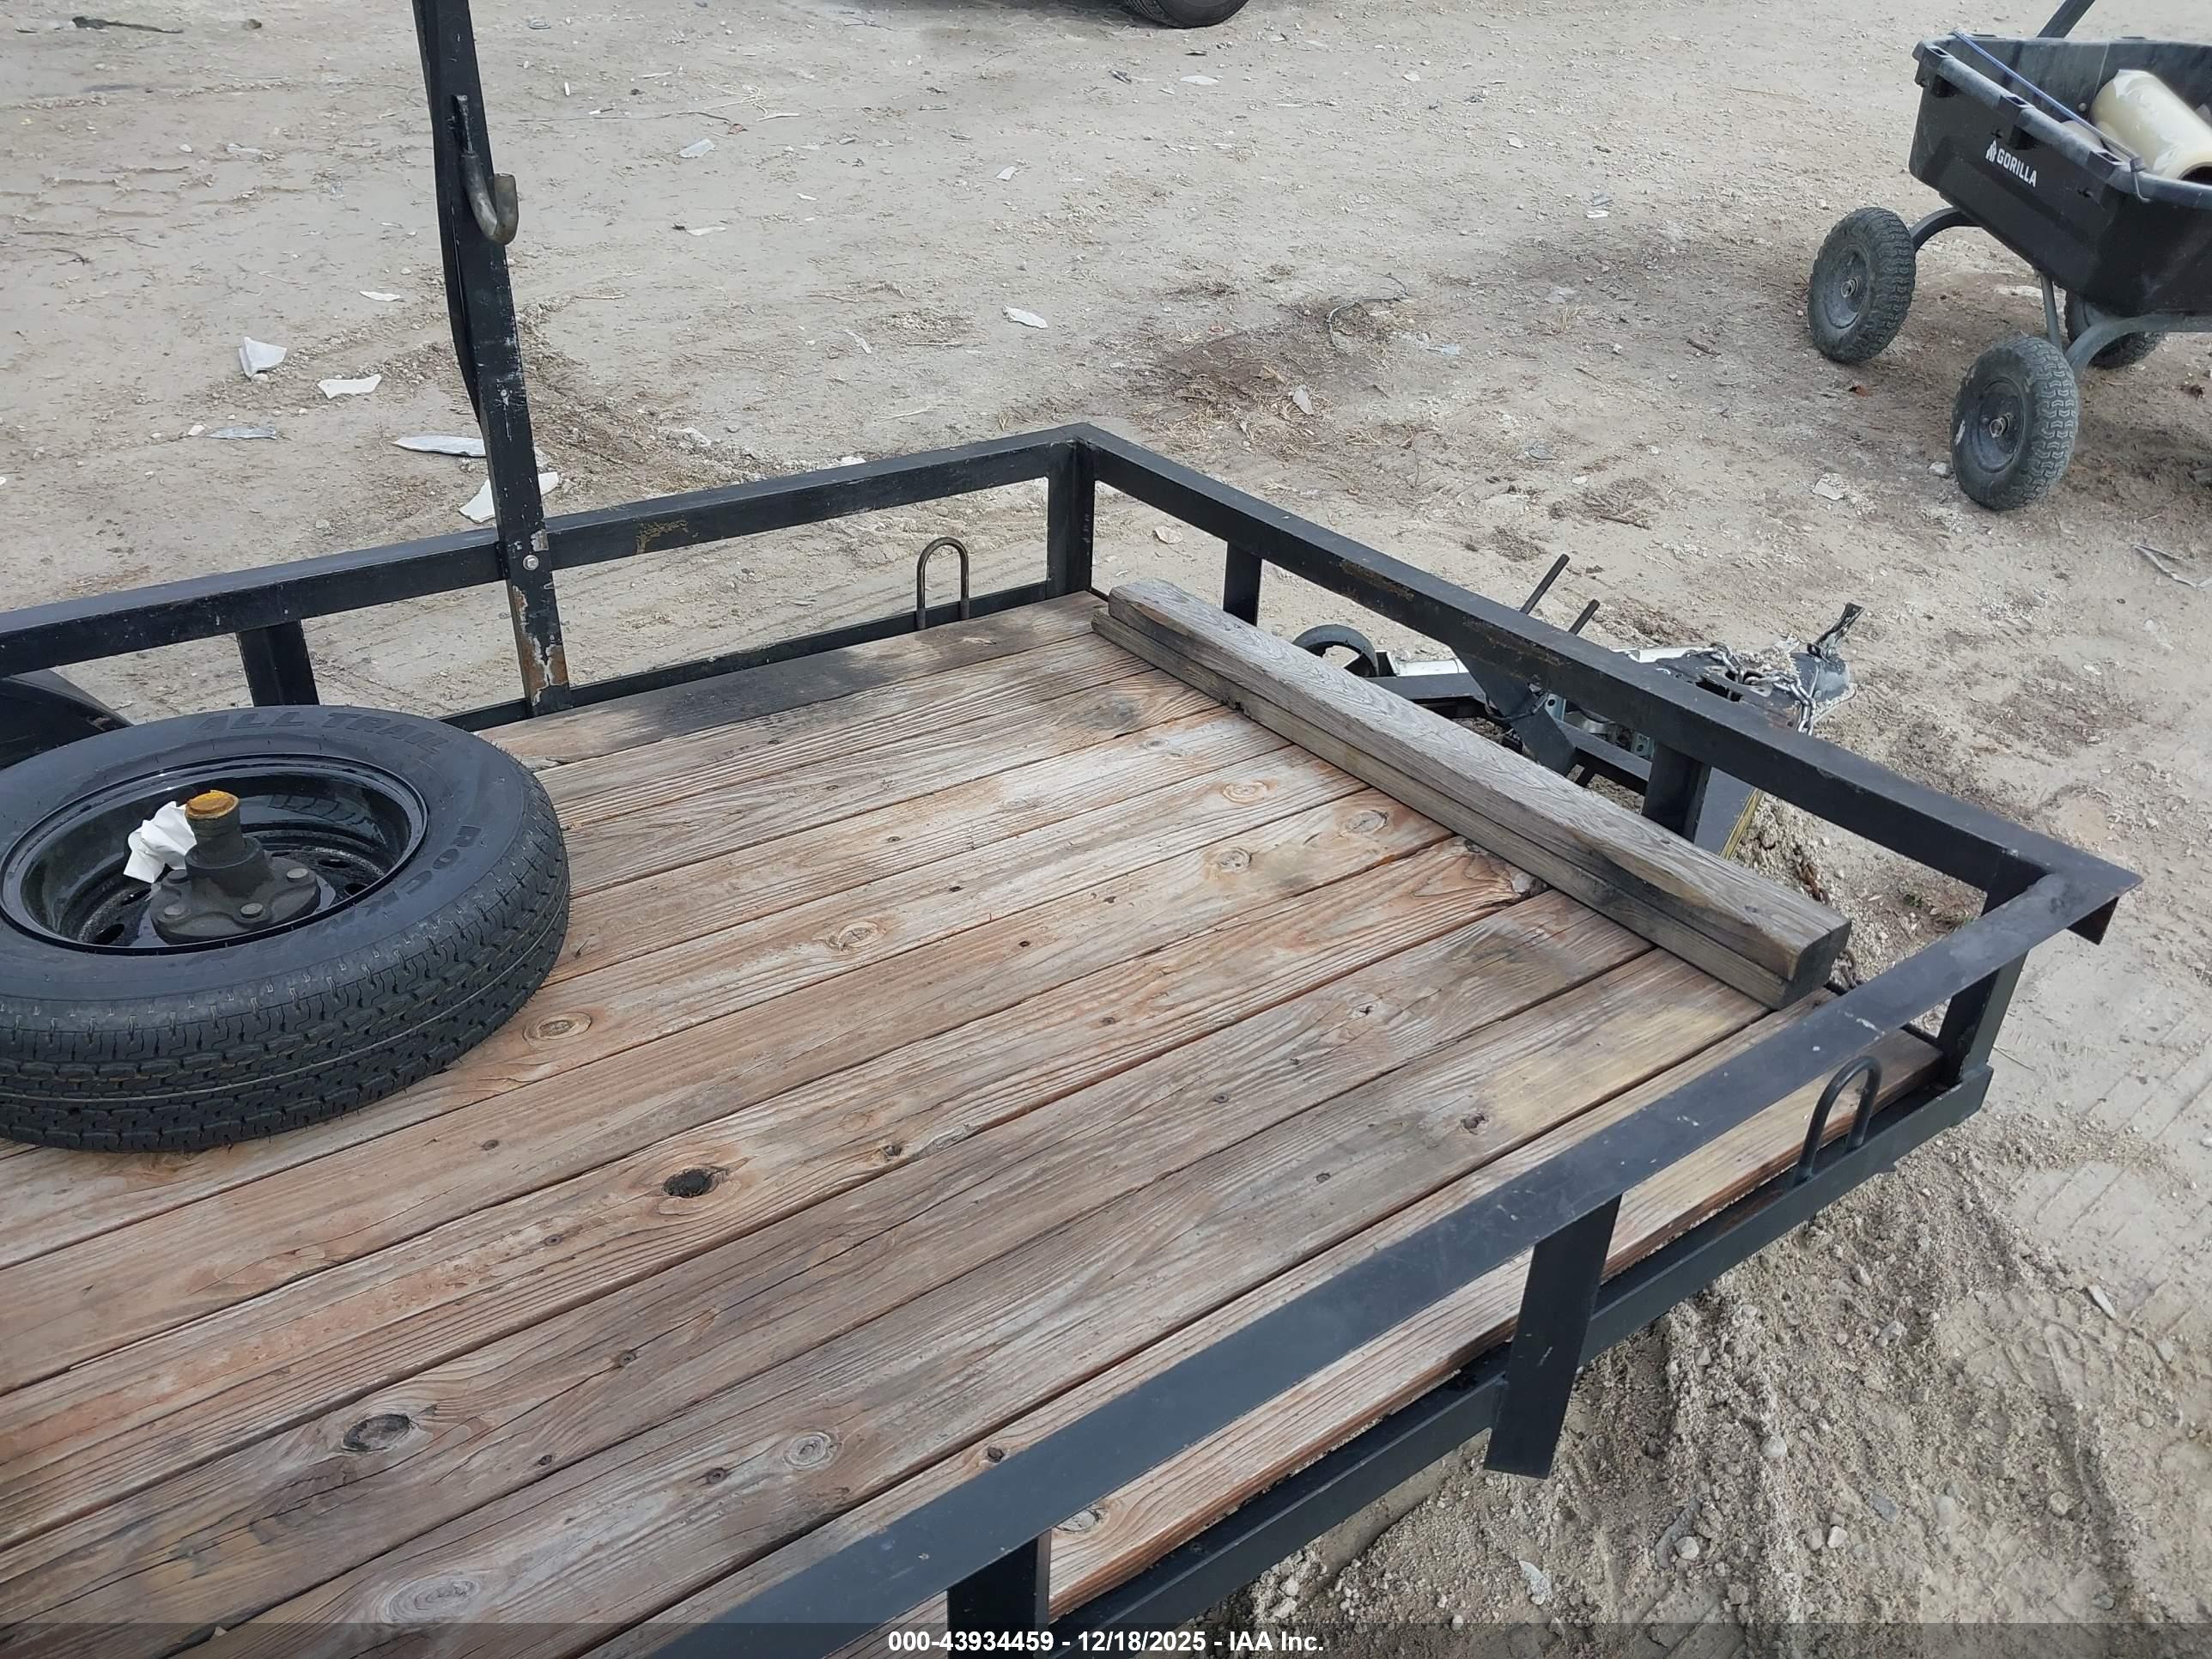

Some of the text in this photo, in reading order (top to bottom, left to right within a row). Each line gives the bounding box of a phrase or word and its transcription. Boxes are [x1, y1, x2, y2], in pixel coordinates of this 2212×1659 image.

[1996, 148, 2037, 188] GORILLA
[197, 711, 449, 756] ALL TRAIL
